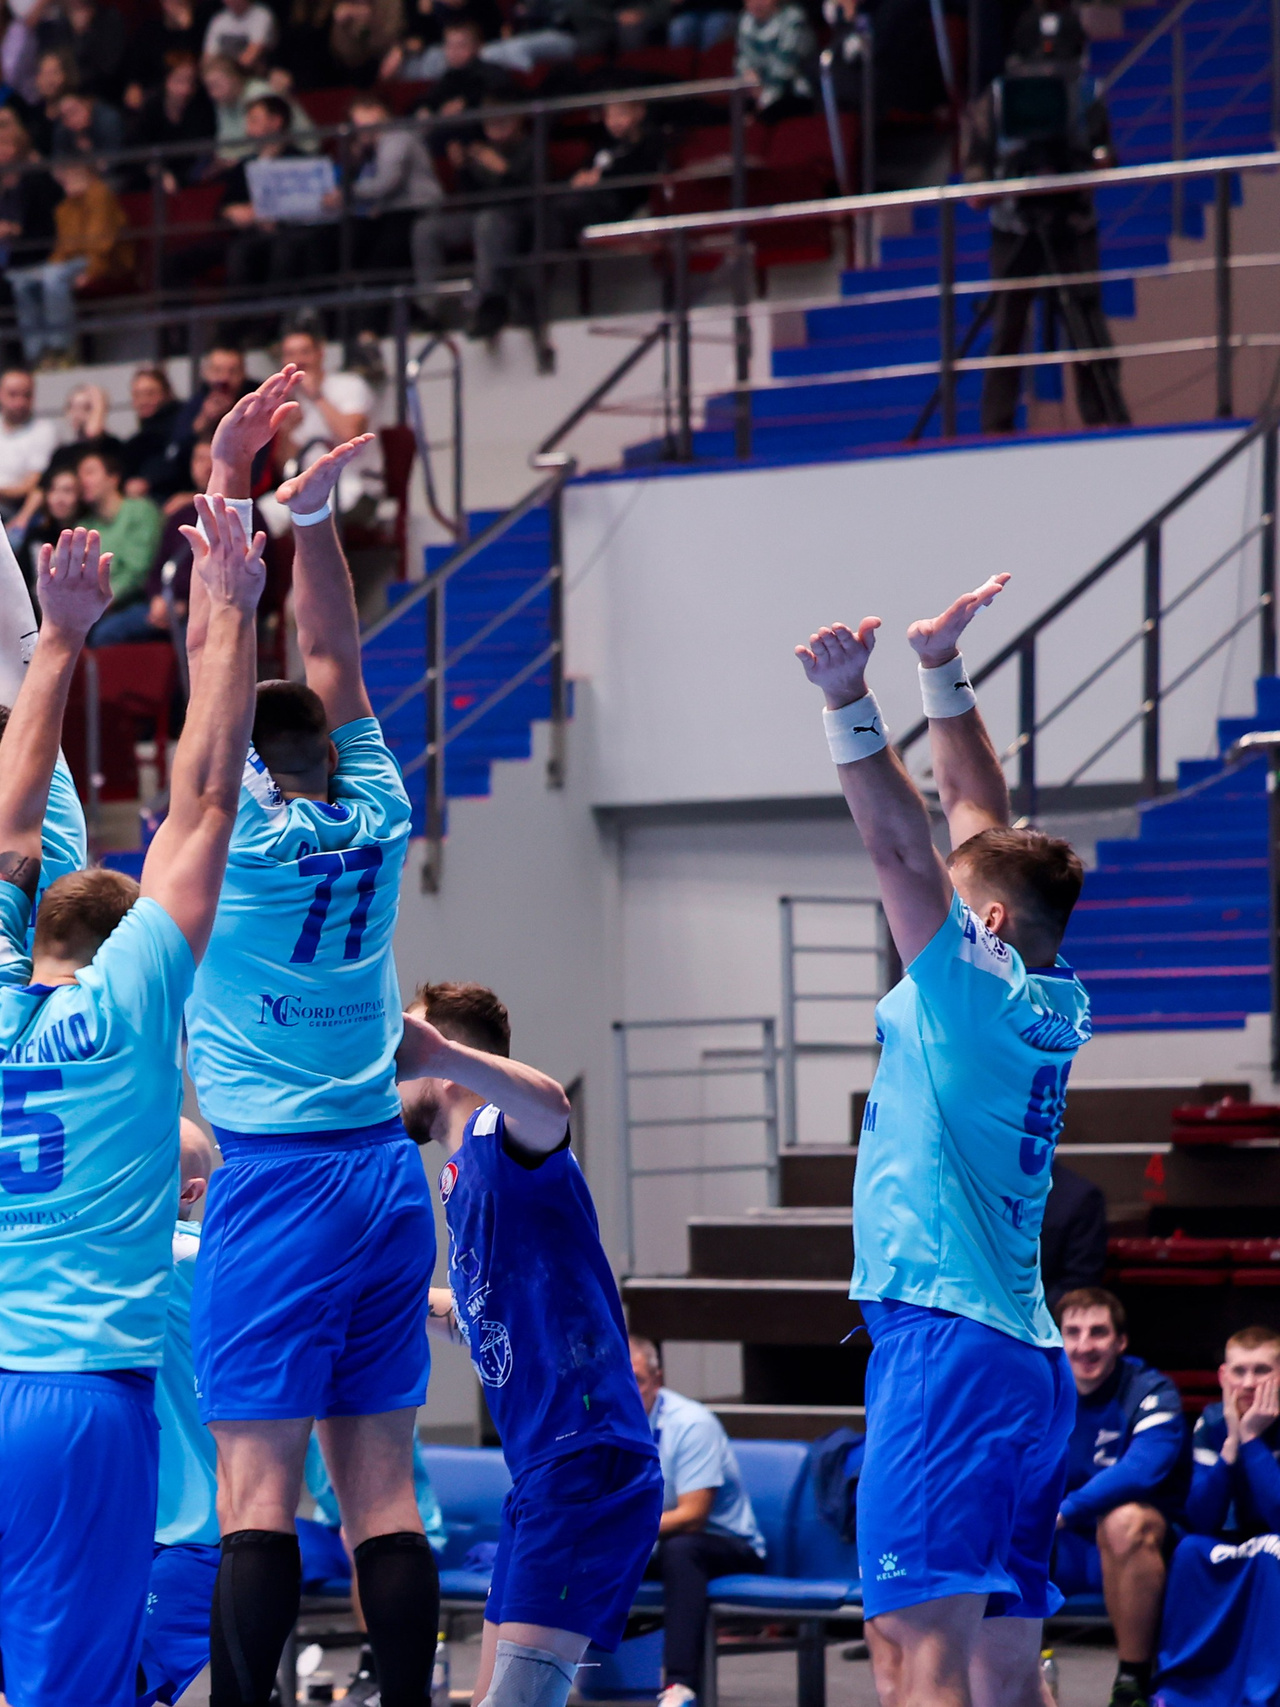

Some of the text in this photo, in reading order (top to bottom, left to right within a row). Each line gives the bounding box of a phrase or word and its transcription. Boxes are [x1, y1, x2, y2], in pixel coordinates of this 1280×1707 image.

[289, 845, 383, 963] 77
[290, 1006, 335, 1019] NORD
[338, 998, 384, 1017] COMPAN
[876, 1568, 907, 1582] KELME
